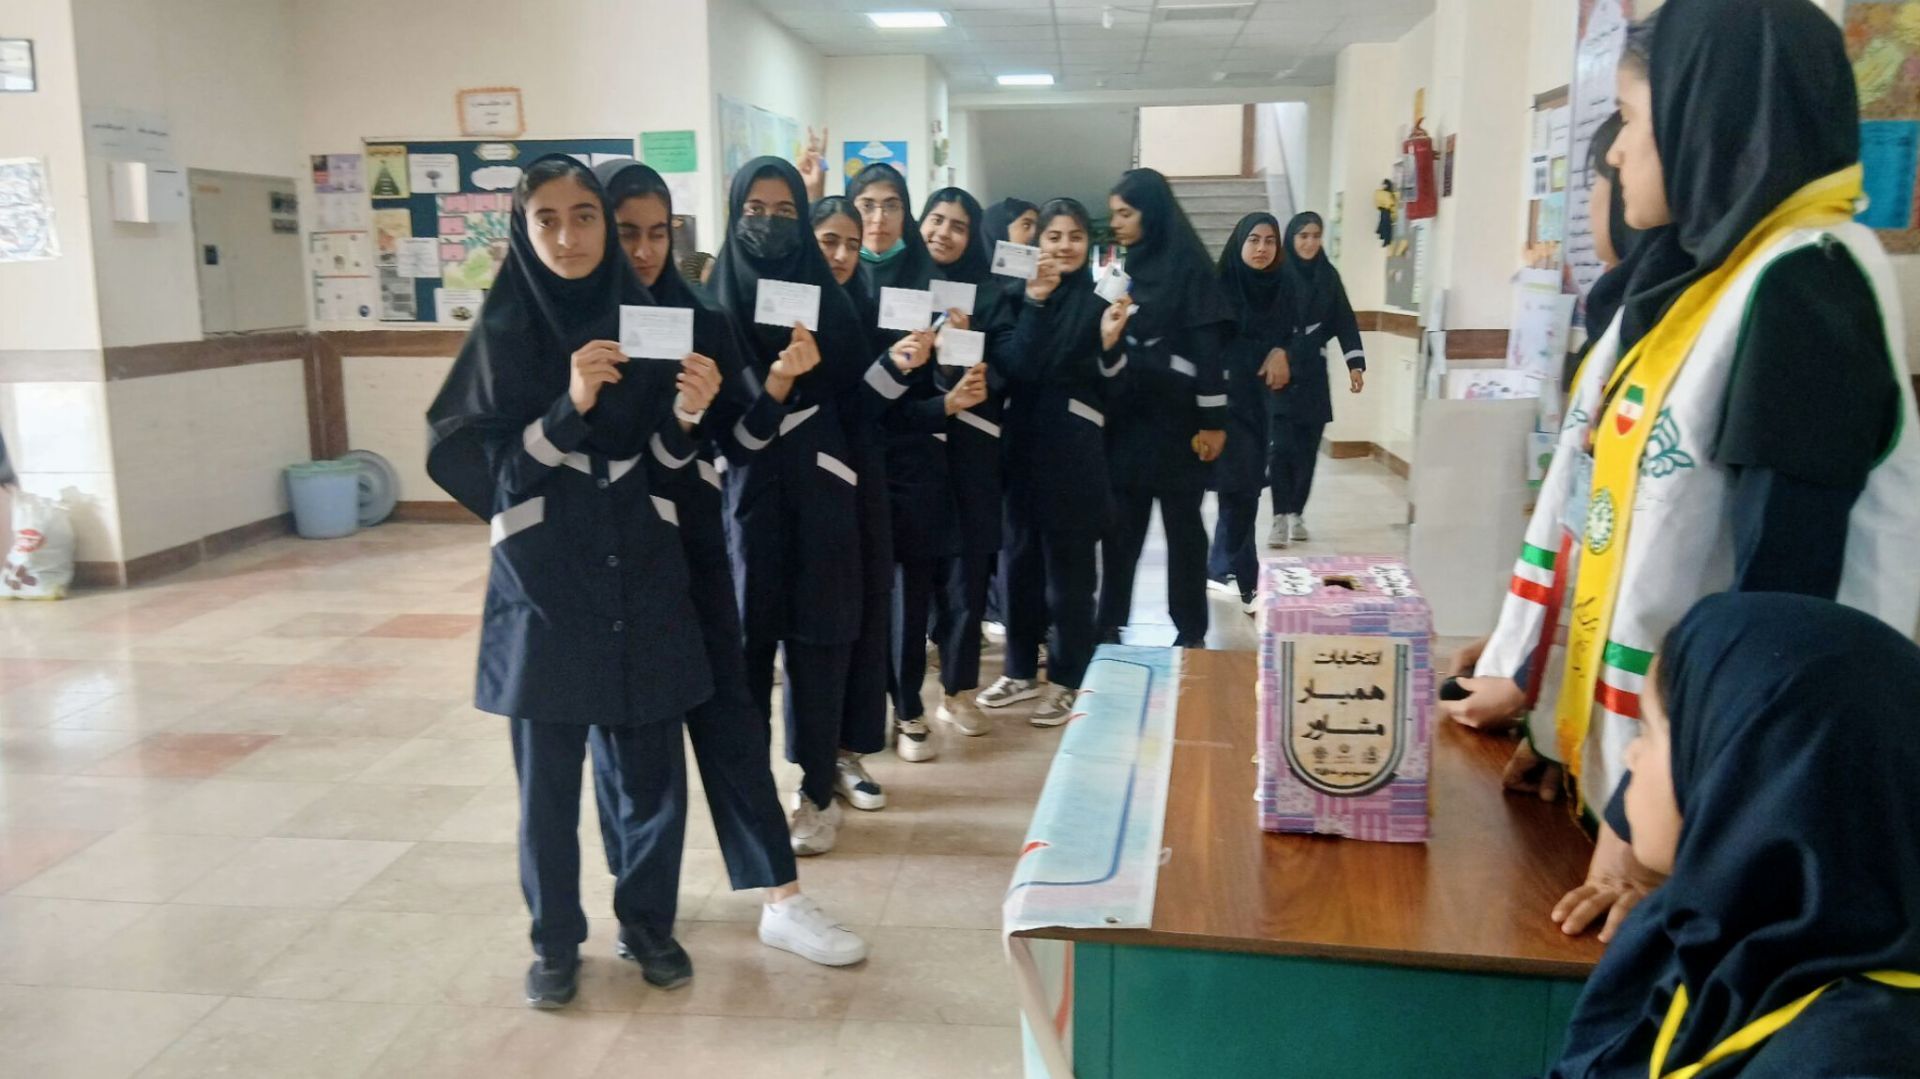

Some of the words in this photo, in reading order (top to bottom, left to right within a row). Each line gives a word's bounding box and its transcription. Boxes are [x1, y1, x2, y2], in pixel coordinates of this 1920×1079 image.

[1313, 648, 1383, 669] انتخابات
[1297, 679, 1385, 704] همیار
[1301, 713, 1385, 741] مشاور
